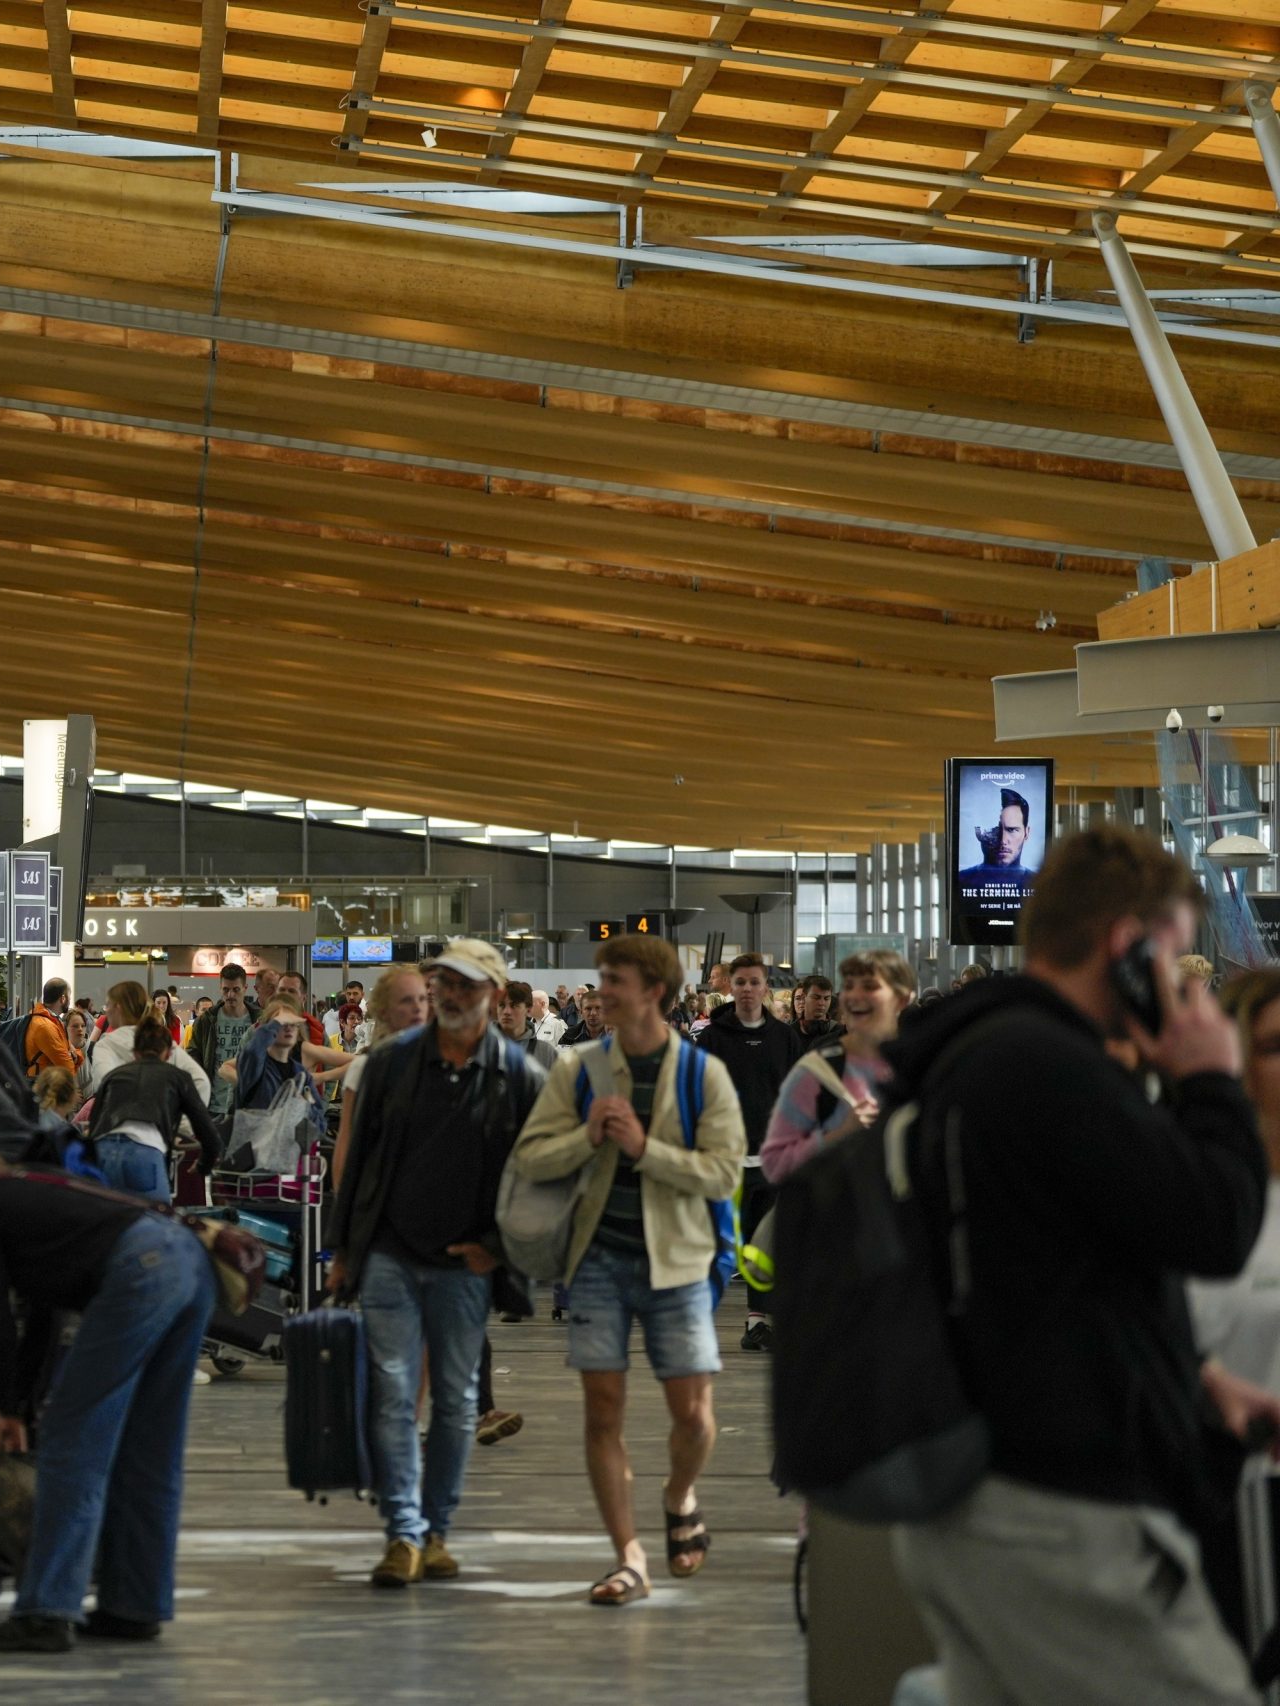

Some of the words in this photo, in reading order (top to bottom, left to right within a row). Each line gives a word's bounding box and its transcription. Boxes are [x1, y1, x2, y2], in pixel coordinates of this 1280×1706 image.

[980, 772, 1004, 781] prime
[1004, 772, 1026, 780] video
[21, 870, 41, 885] SAS
[962, 888, 978, 898] THE
[980, 888, 1021, 898] TERMINAL
[21, 917, 42, 931] SAS
[600, 924, 609, 938] 5
[638, 917, 648, 932] 4
